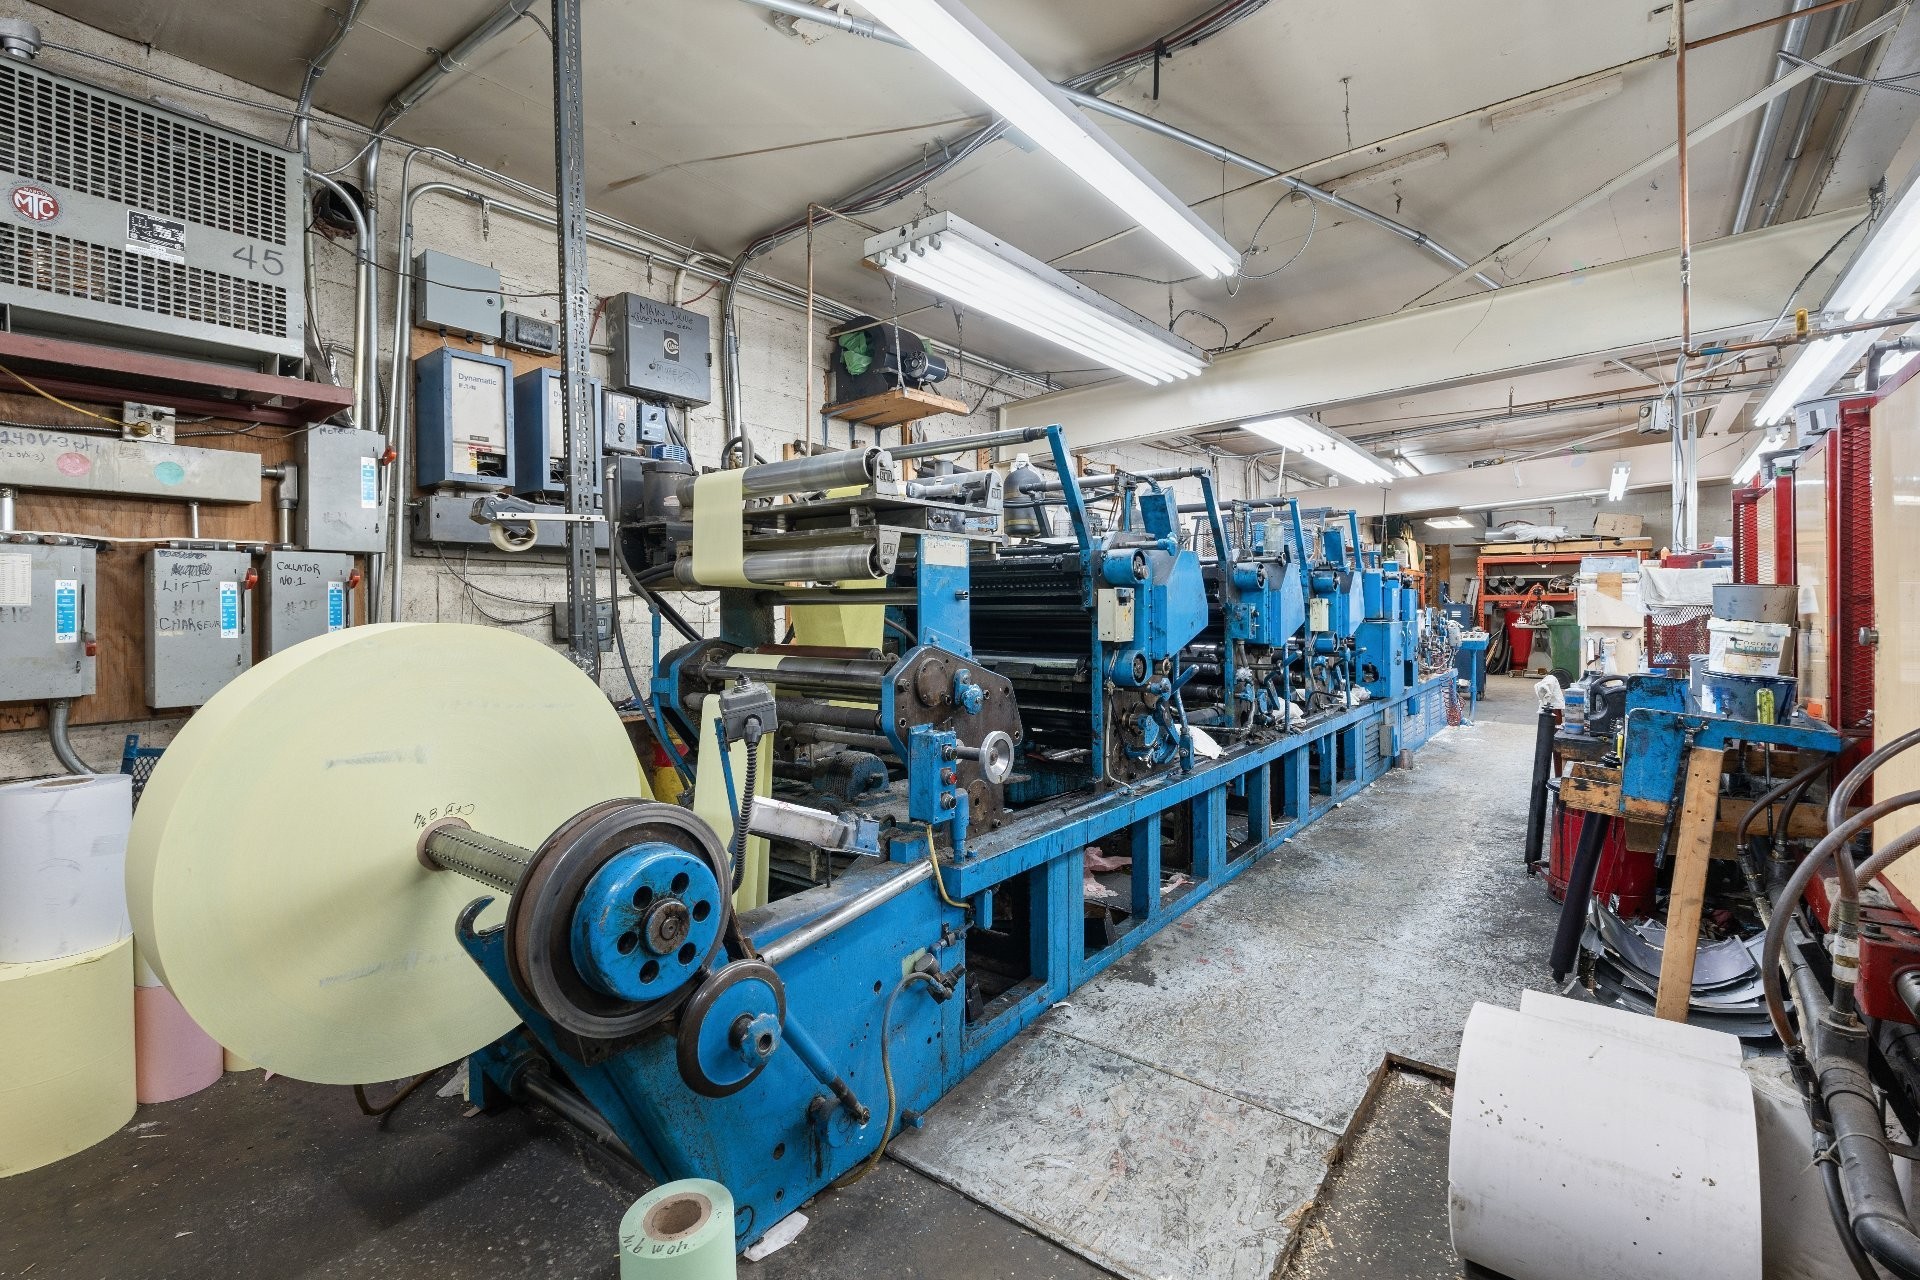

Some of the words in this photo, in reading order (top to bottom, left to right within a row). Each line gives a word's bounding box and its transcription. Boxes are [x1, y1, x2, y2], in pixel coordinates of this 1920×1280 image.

[14, 189, 55, 219] MTC
[232, 244, 284, 276] 45
[458, 372, 497, 386] Dynamatic
[320, 427, 358, 436] MOTEUR
[276, 561, 321, 576] COLLATOR
